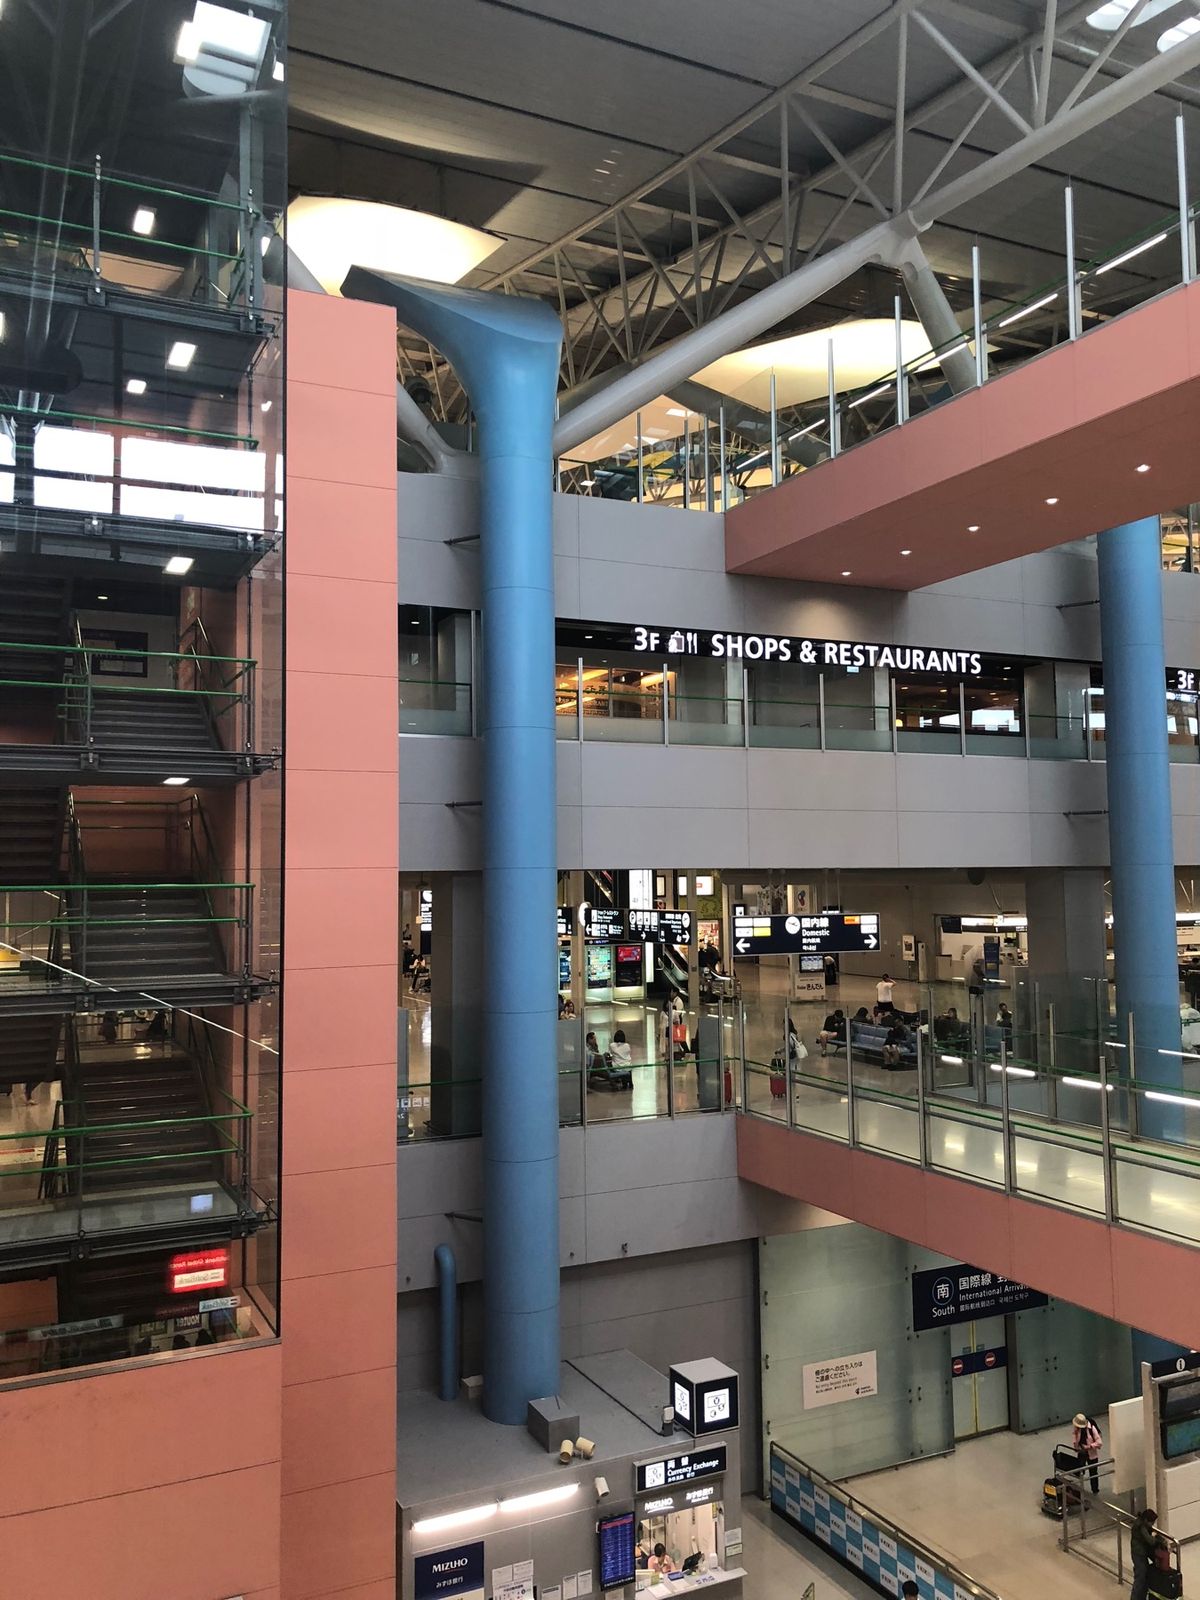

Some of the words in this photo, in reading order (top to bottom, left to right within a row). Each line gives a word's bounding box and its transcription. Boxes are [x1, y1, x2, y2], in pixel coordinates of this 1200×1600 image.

[634, 627, 660, 651] 3F
[711, 634, 791, 662] SHOPS
[800, 640, 818, 664] &
[824, 642, 982, 674] RESTAURANTS
[801, 929, 830, 937] Domestic
[959, 1273, 992, 1290] 国際線
[937, 1283, 950, 1300] 南
[959, 1286, 1002, 1302] International
[1004, 1283, 1029, 1293] Arriva
[932, 1304, 956, 1318] South
[667, 1466, 692, 1477] Currency
[693, 1459, 719, 1470] Exchange
[644, 1498, 673, 1511] MIZUHO
[432, 1558, 468, 1573] MIZUHO
